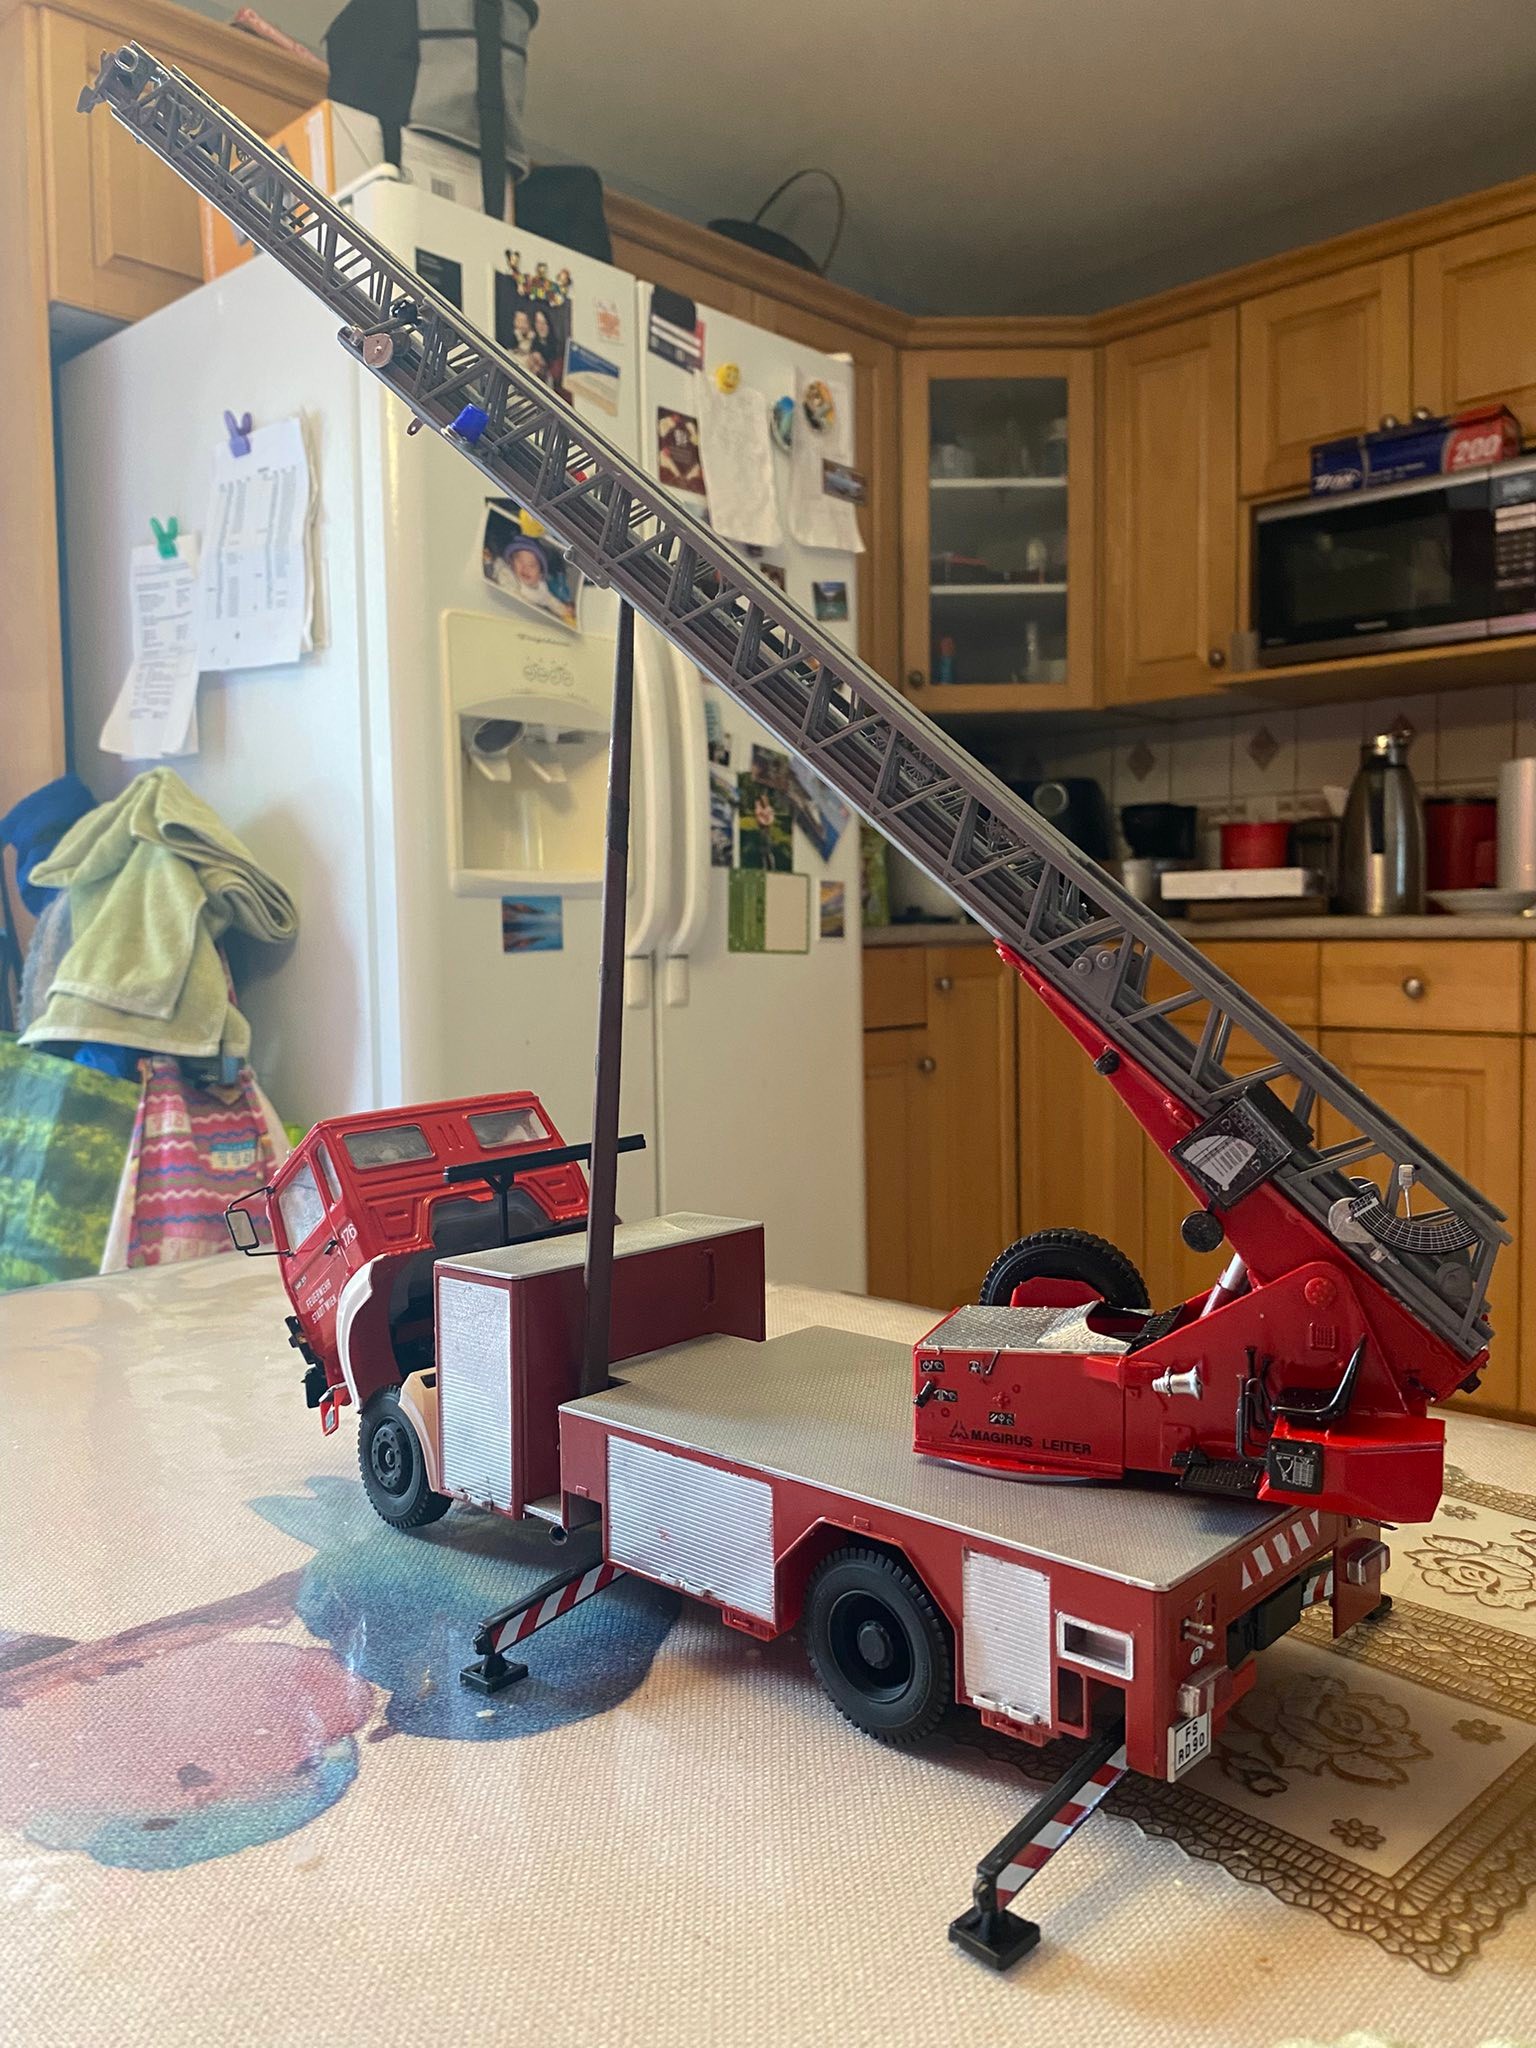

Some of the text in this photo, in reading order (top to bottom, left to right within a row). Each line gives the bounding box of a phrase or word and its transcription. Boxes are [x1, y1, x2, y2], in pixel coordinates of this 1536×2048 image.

[1453, 434, 1500, 464] 200
[341, 1223, 358, 1248] 176
[305, 1279, 332, 1310] FEUERWEHR
[971, 1429, 1092, 1455] MAGIRUS LEITER
[1185, 1721, 1198, 1742] FS
